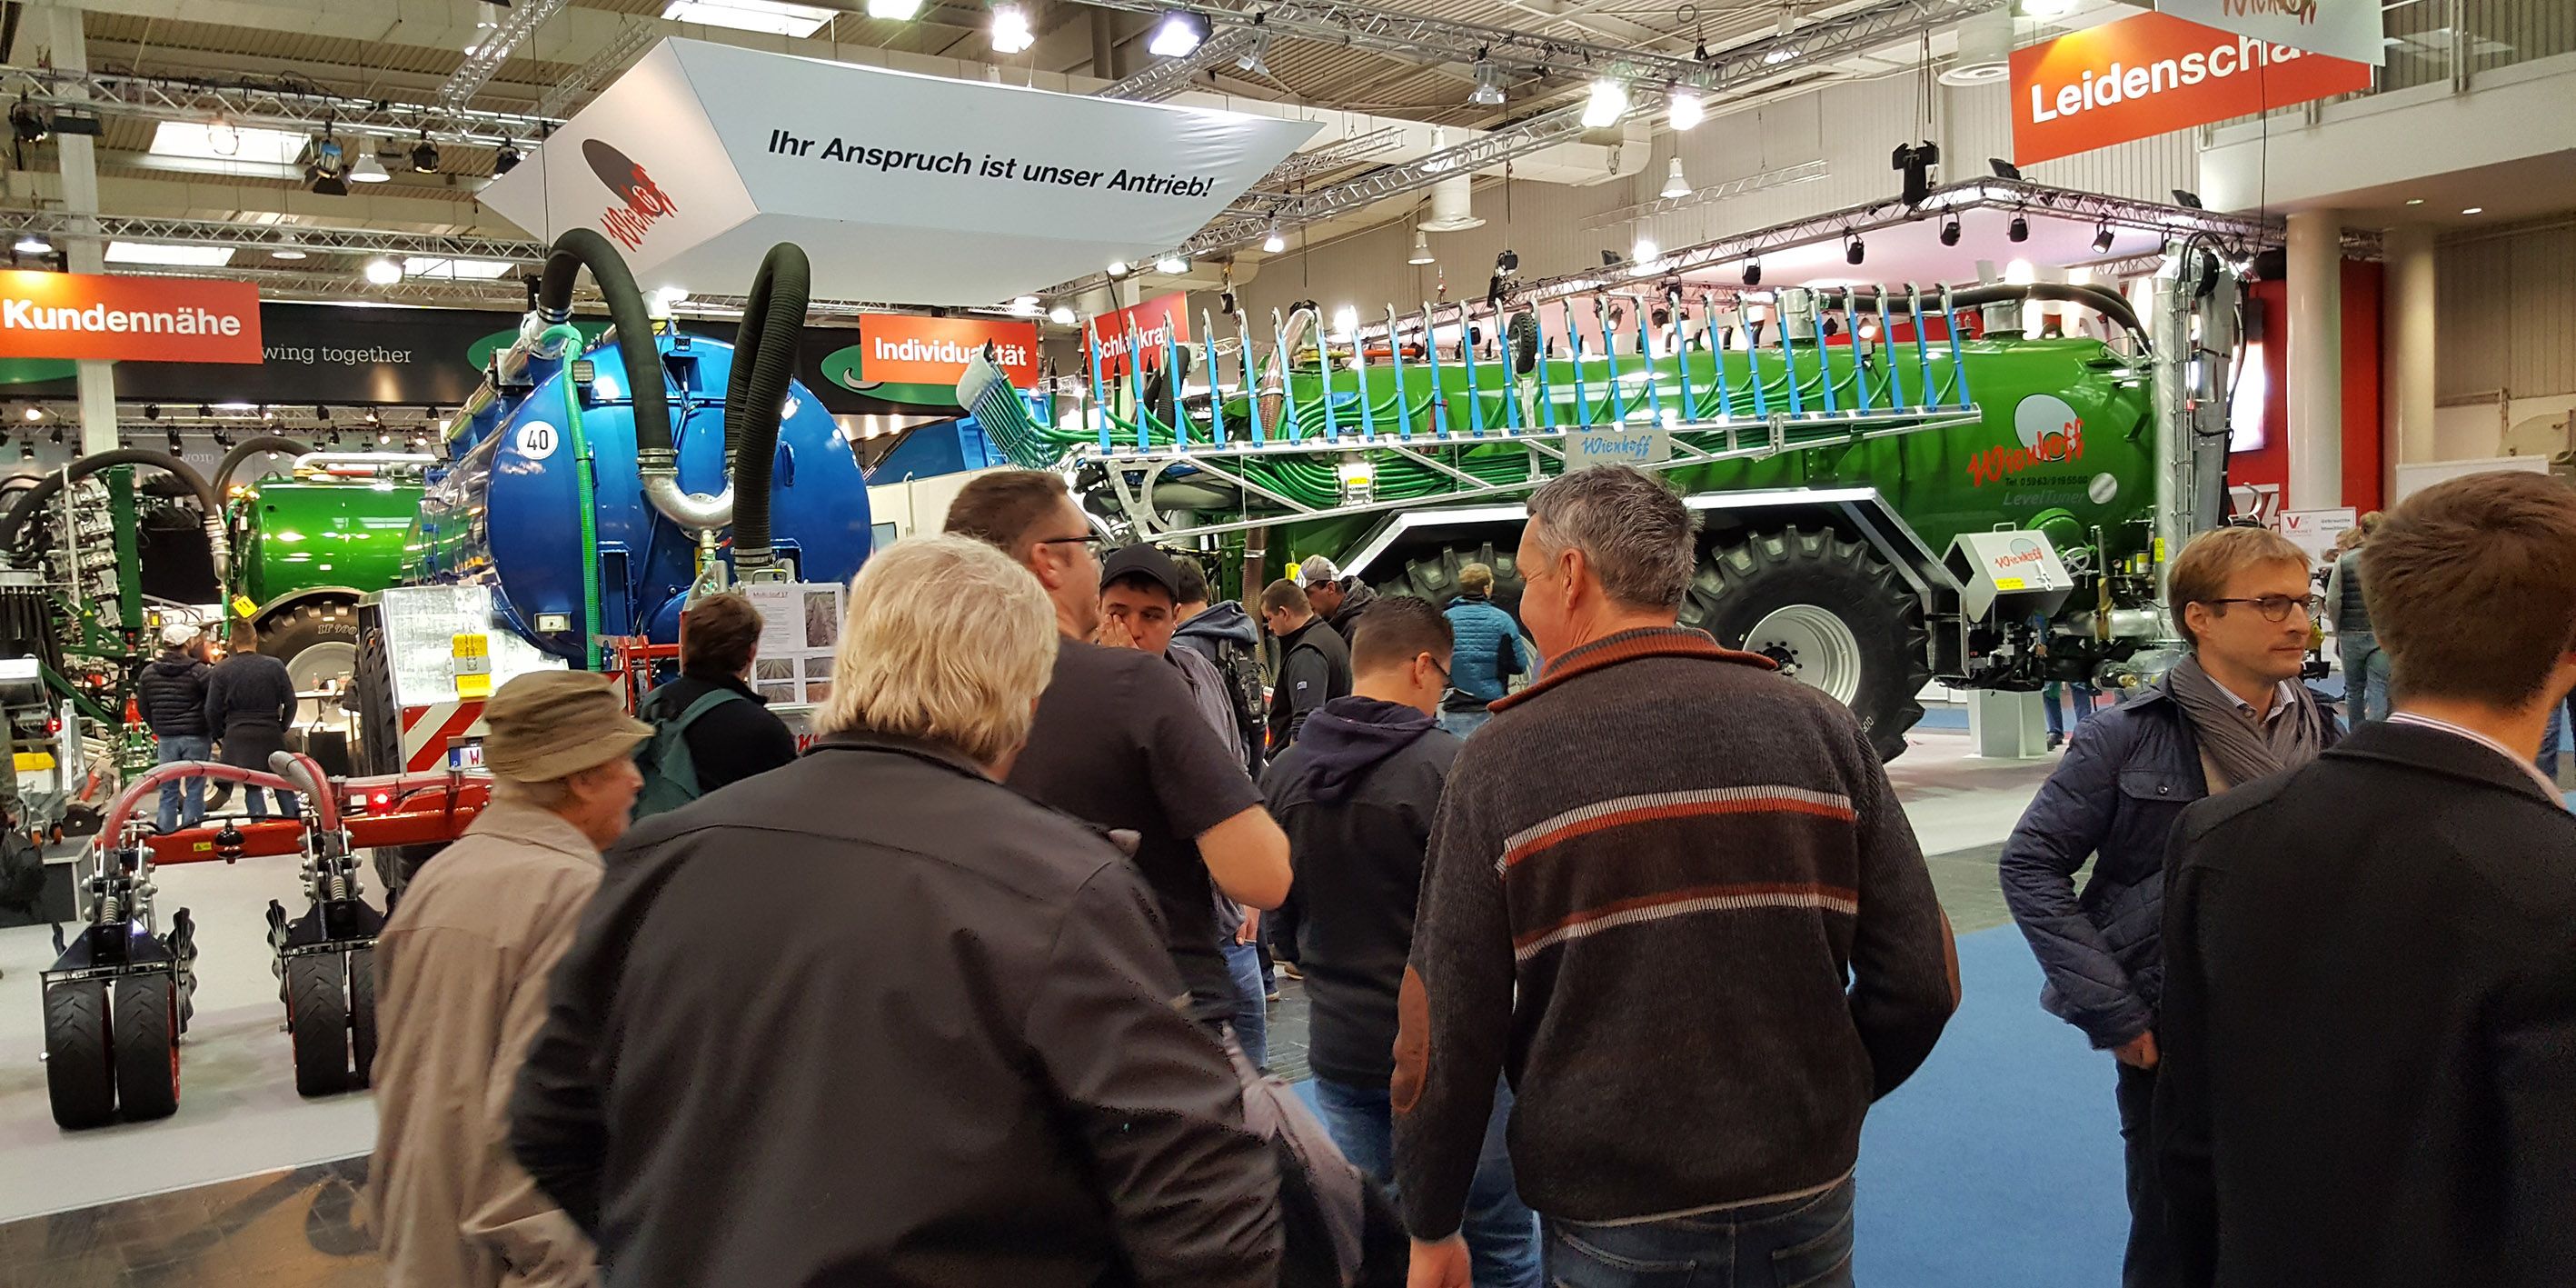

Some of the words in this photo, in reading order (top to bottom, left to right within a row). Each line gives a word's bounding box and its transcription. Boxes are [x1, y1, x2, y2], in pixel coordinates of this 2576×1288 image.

[2031, 34, 2314, 124] Leidenscha
[769, 129, 815, 157] Ihr
[821, 137, 972, 172] Anspruch
[980, 154, 1017, 179] ist
[1022, 165, 1104, 188] unser
[1106, 169, 1214, 197] Antrieb!
[3, 298, 241, 336] Kundennähe
[322, 344, 412, 364] together
[875, 337, 1027, 366] Individuatät
[527, 429, 549, 450] 40
[1581, 435, 1653, 456] Wienhoff
[1966, 418, 2084, 488] Wienhoff
